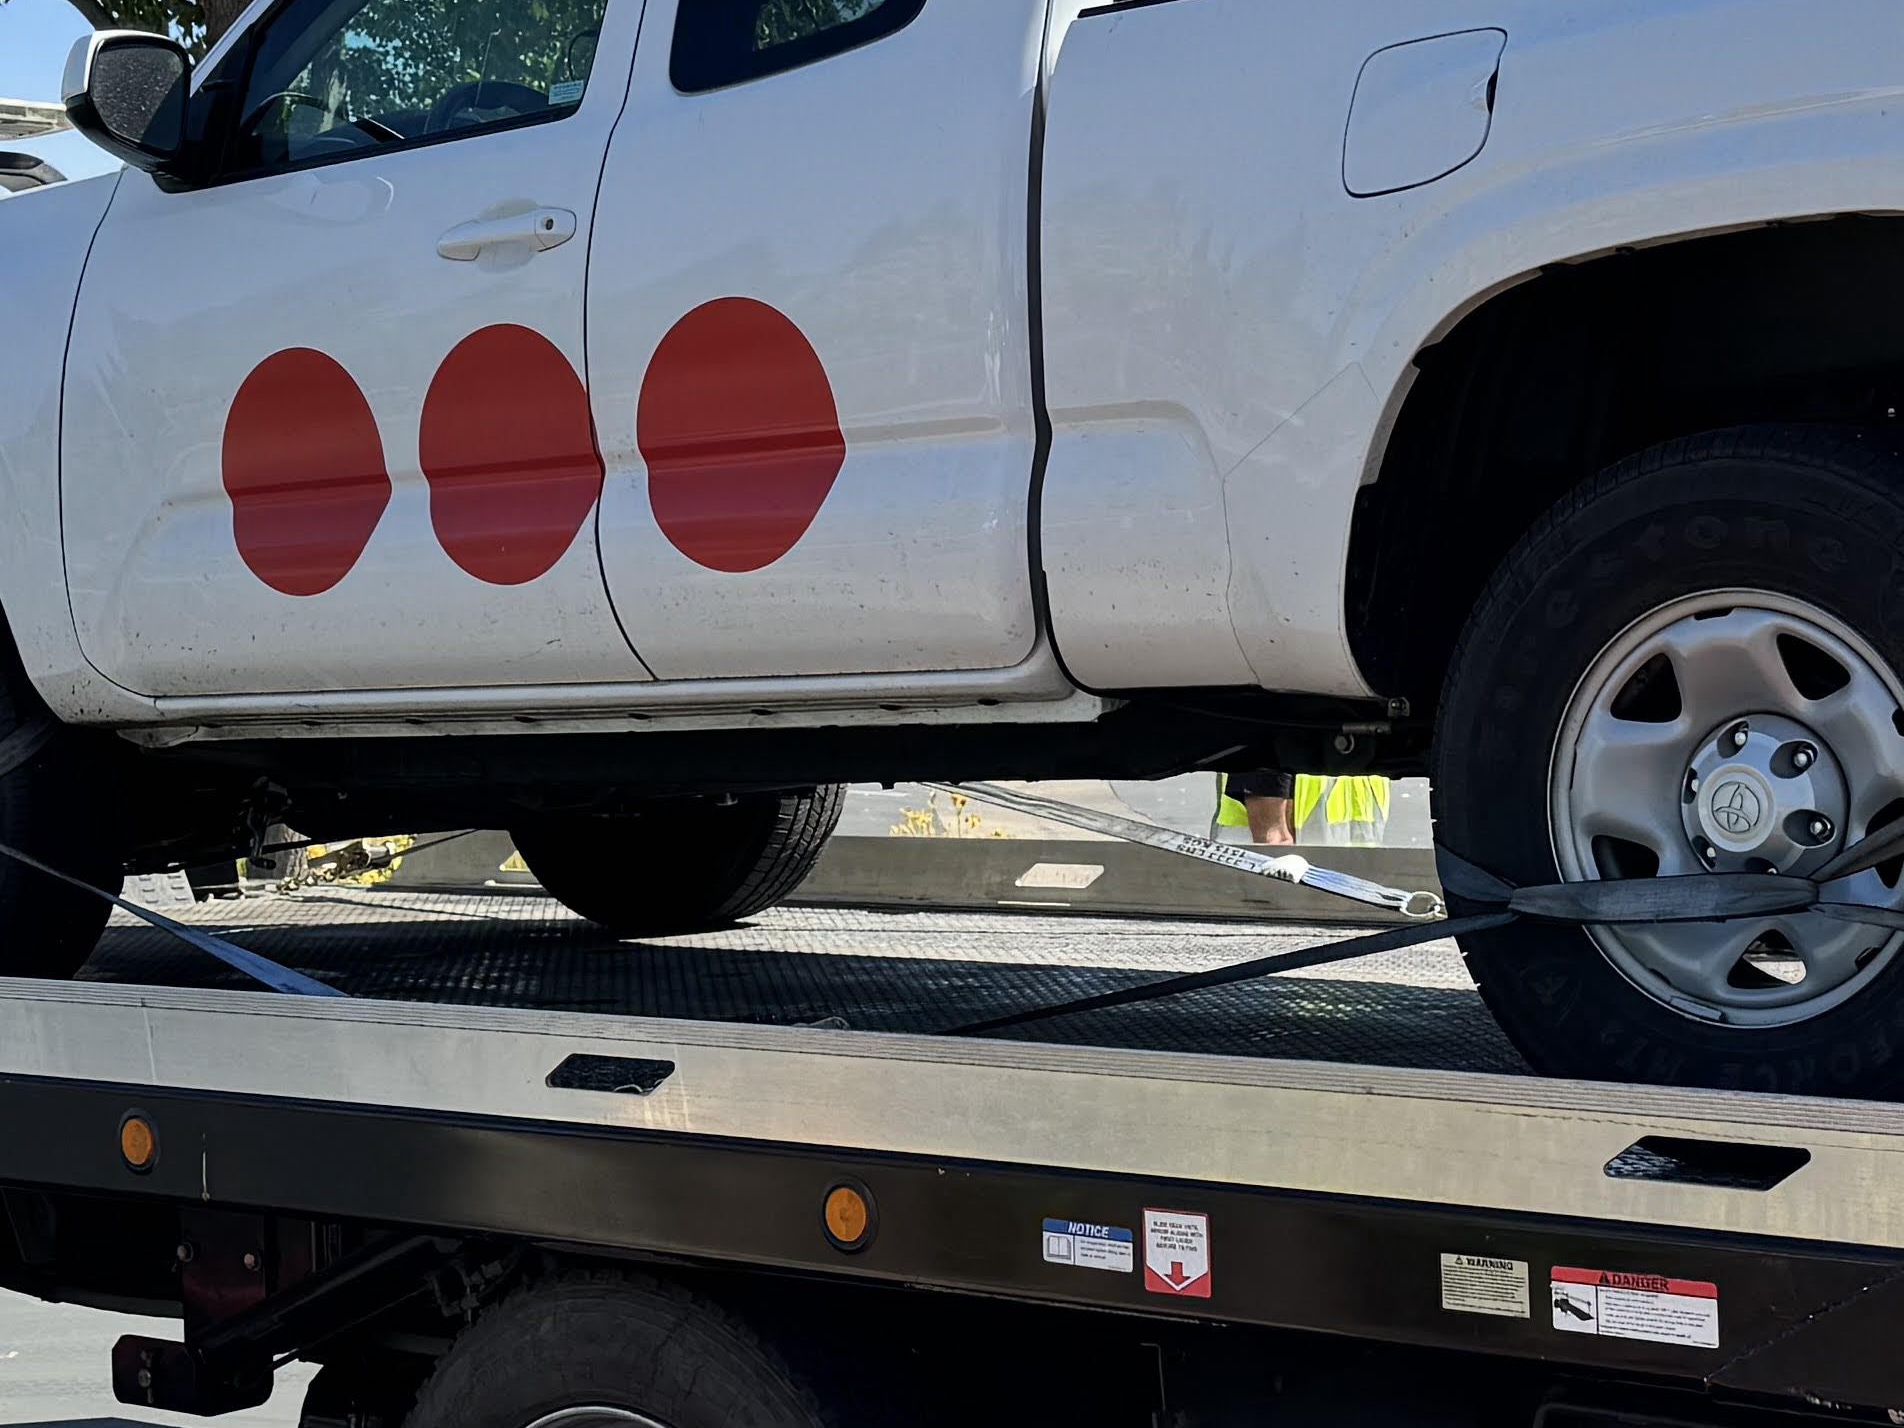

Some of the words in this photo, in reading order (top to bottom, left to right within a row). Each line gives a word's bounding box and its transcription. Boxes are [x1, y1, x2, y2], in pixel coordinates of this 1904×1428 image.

[1067, 1221, 1110, 1239] NOTICE
[1466, 1257, 1514, 1271] WARNING
[1611, 1274, 1670, 1291] DANGER
